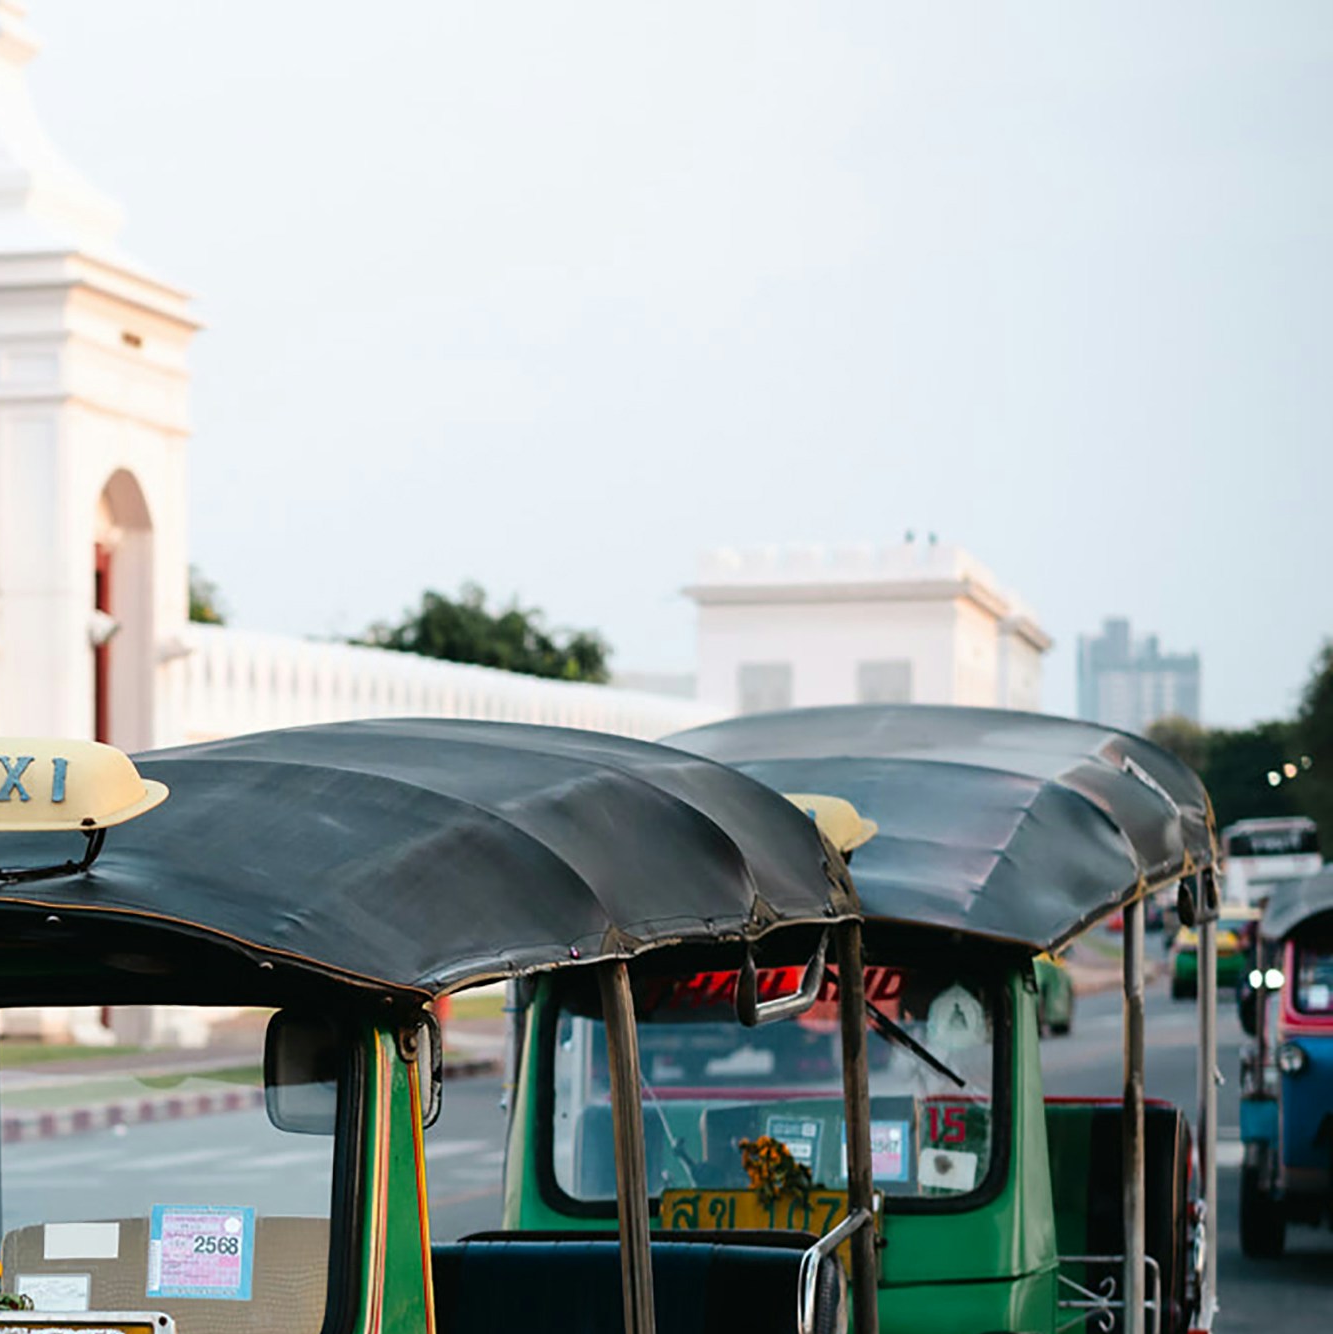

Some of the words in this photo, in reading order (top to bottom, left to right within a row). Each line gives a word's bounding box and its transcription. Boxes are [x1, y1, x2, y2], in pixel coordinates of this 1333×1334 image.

[642, 966, 907, 1005] THAILAD
[927, 1106, 966, 1143] 15
[193, 1235, 240, 1256] 2568
